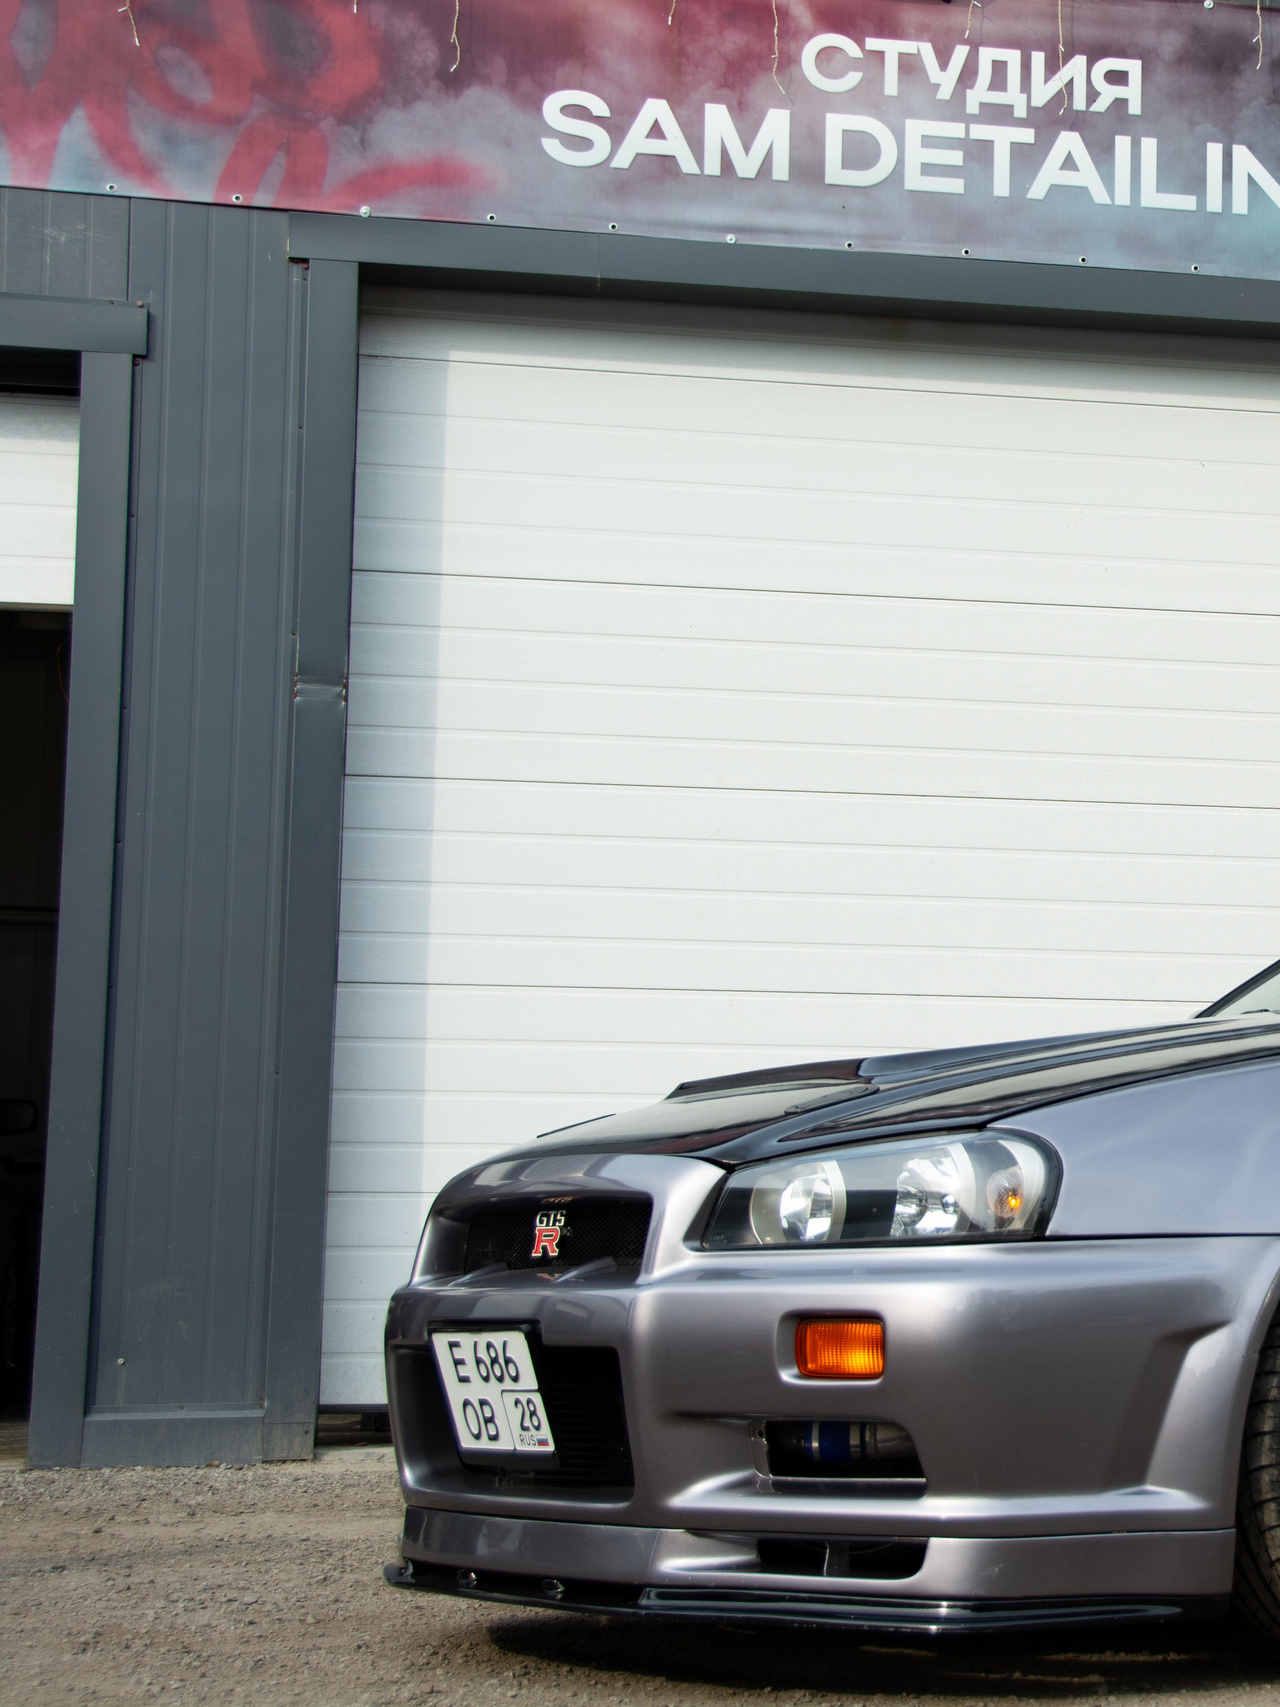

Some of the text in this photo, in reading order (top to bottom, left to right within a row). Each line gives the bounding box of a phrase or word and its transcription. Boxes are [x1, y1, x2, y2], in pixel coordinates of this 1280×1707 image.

[801, 33, 1142, 118] СТУДИЯ
[541, 90, 790, 181] SAM
[514, 1397, 542, 1432] 28
[519, 1434, 537, 1446] RUS
